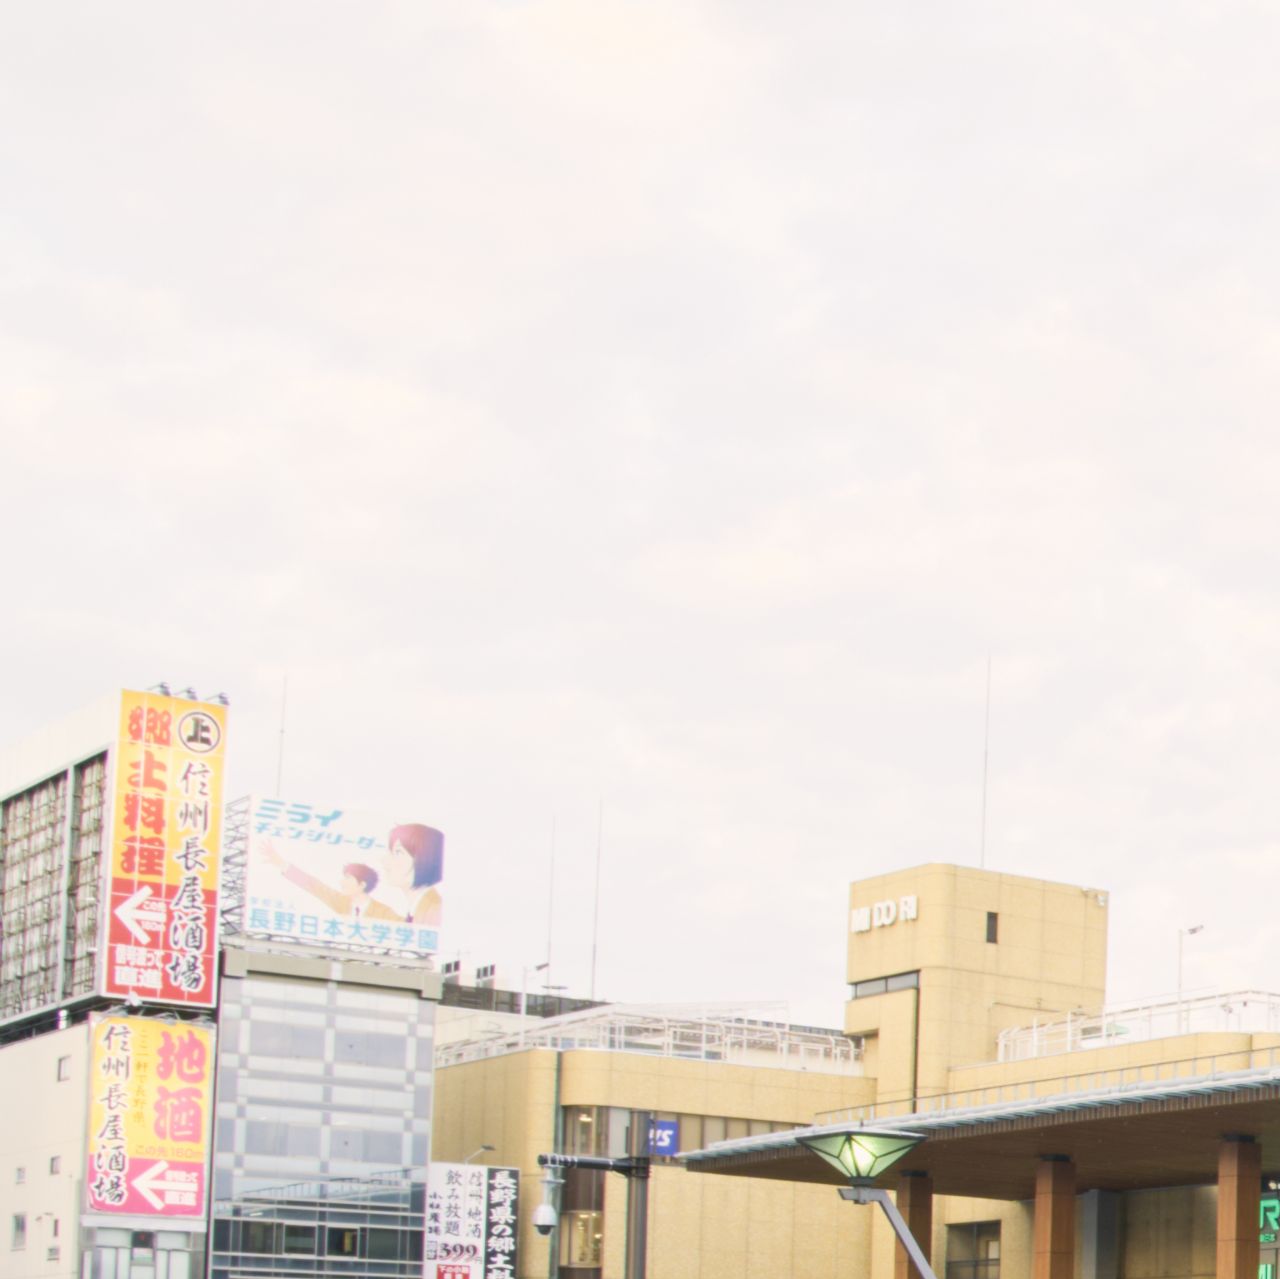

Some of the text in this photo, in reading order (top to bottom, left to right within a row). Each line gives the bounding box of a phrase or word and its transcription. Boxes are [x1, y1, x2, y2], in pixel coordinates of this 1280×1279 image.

[120, 706, 172, 876] 郷土料理
[255, 799, 343, 827] ミライ
[171, 762, 209, 990] 信州長屋酒場
[249, 908, 438, 950] 長野日本大学学園
[95, 1025, 131, 1203] 信州長屋酒場
[154, 1029, 208, 1143] 地酒
[446, 1170, 462, 1237] 飲み放題
